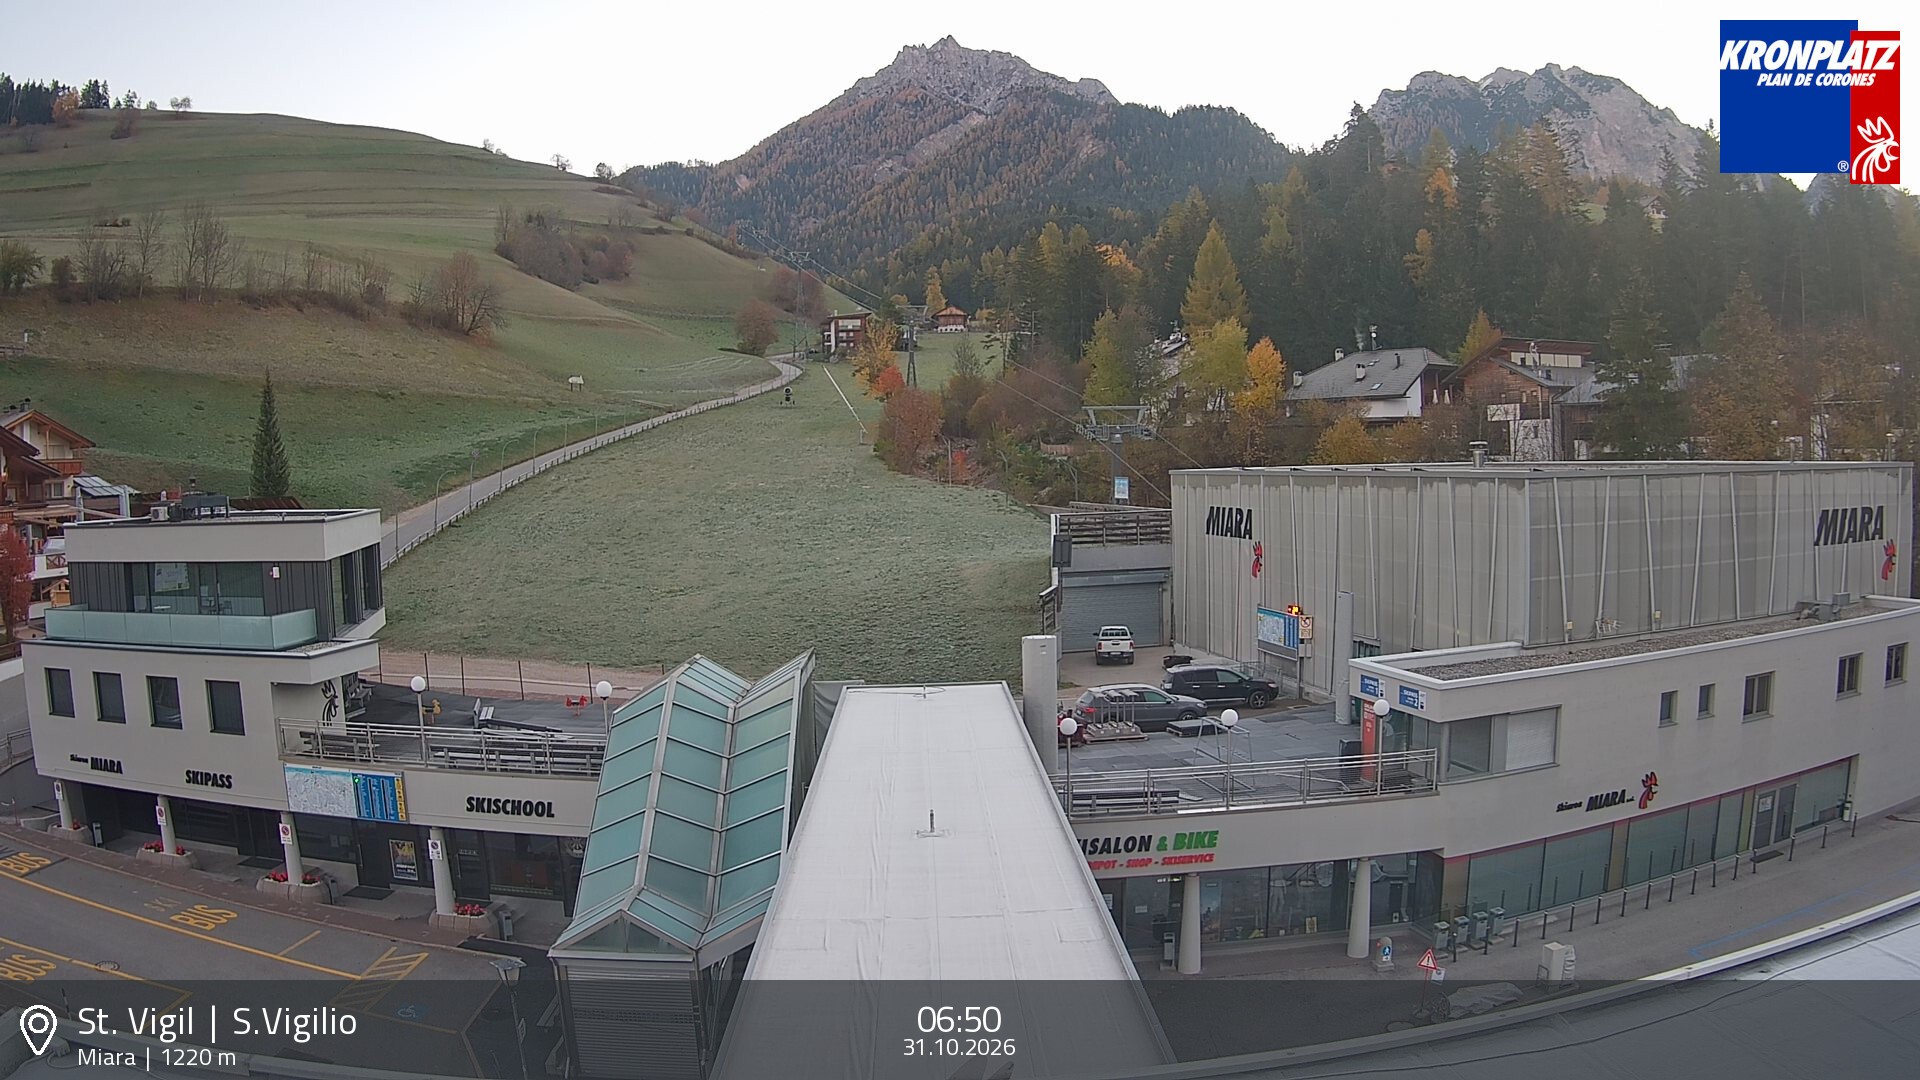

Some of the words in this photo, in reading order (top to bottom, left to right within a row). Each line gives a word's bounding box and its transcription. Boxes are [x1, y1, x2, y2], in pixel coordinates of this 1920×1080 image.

[1205, 505, 1253, 540] MIARA
[1813, 505, 1884, 546] MIARA
[1413, 698, 1419, 707] 2
[90, 756, 123, 775] MIARA
[185, 769, 233, 789] SKIPASS
[466, 796, 555, 818] SKISCHOOL
[1585, 788, 1626, 812] MIARA
[1077, 835, 1153, 856] ISALON
[1156, 836, 1168, 852] &
[1173, 829, 1219, 851] BIKE
[0, 852, 52, 875] BUS
[1125, 857, 1153, 869] SHOP
[1160, 853, 1215, 867] SKISERVICE
[169, 903, 239, 932] BUS
[0, 953, 57, 985] BUS
